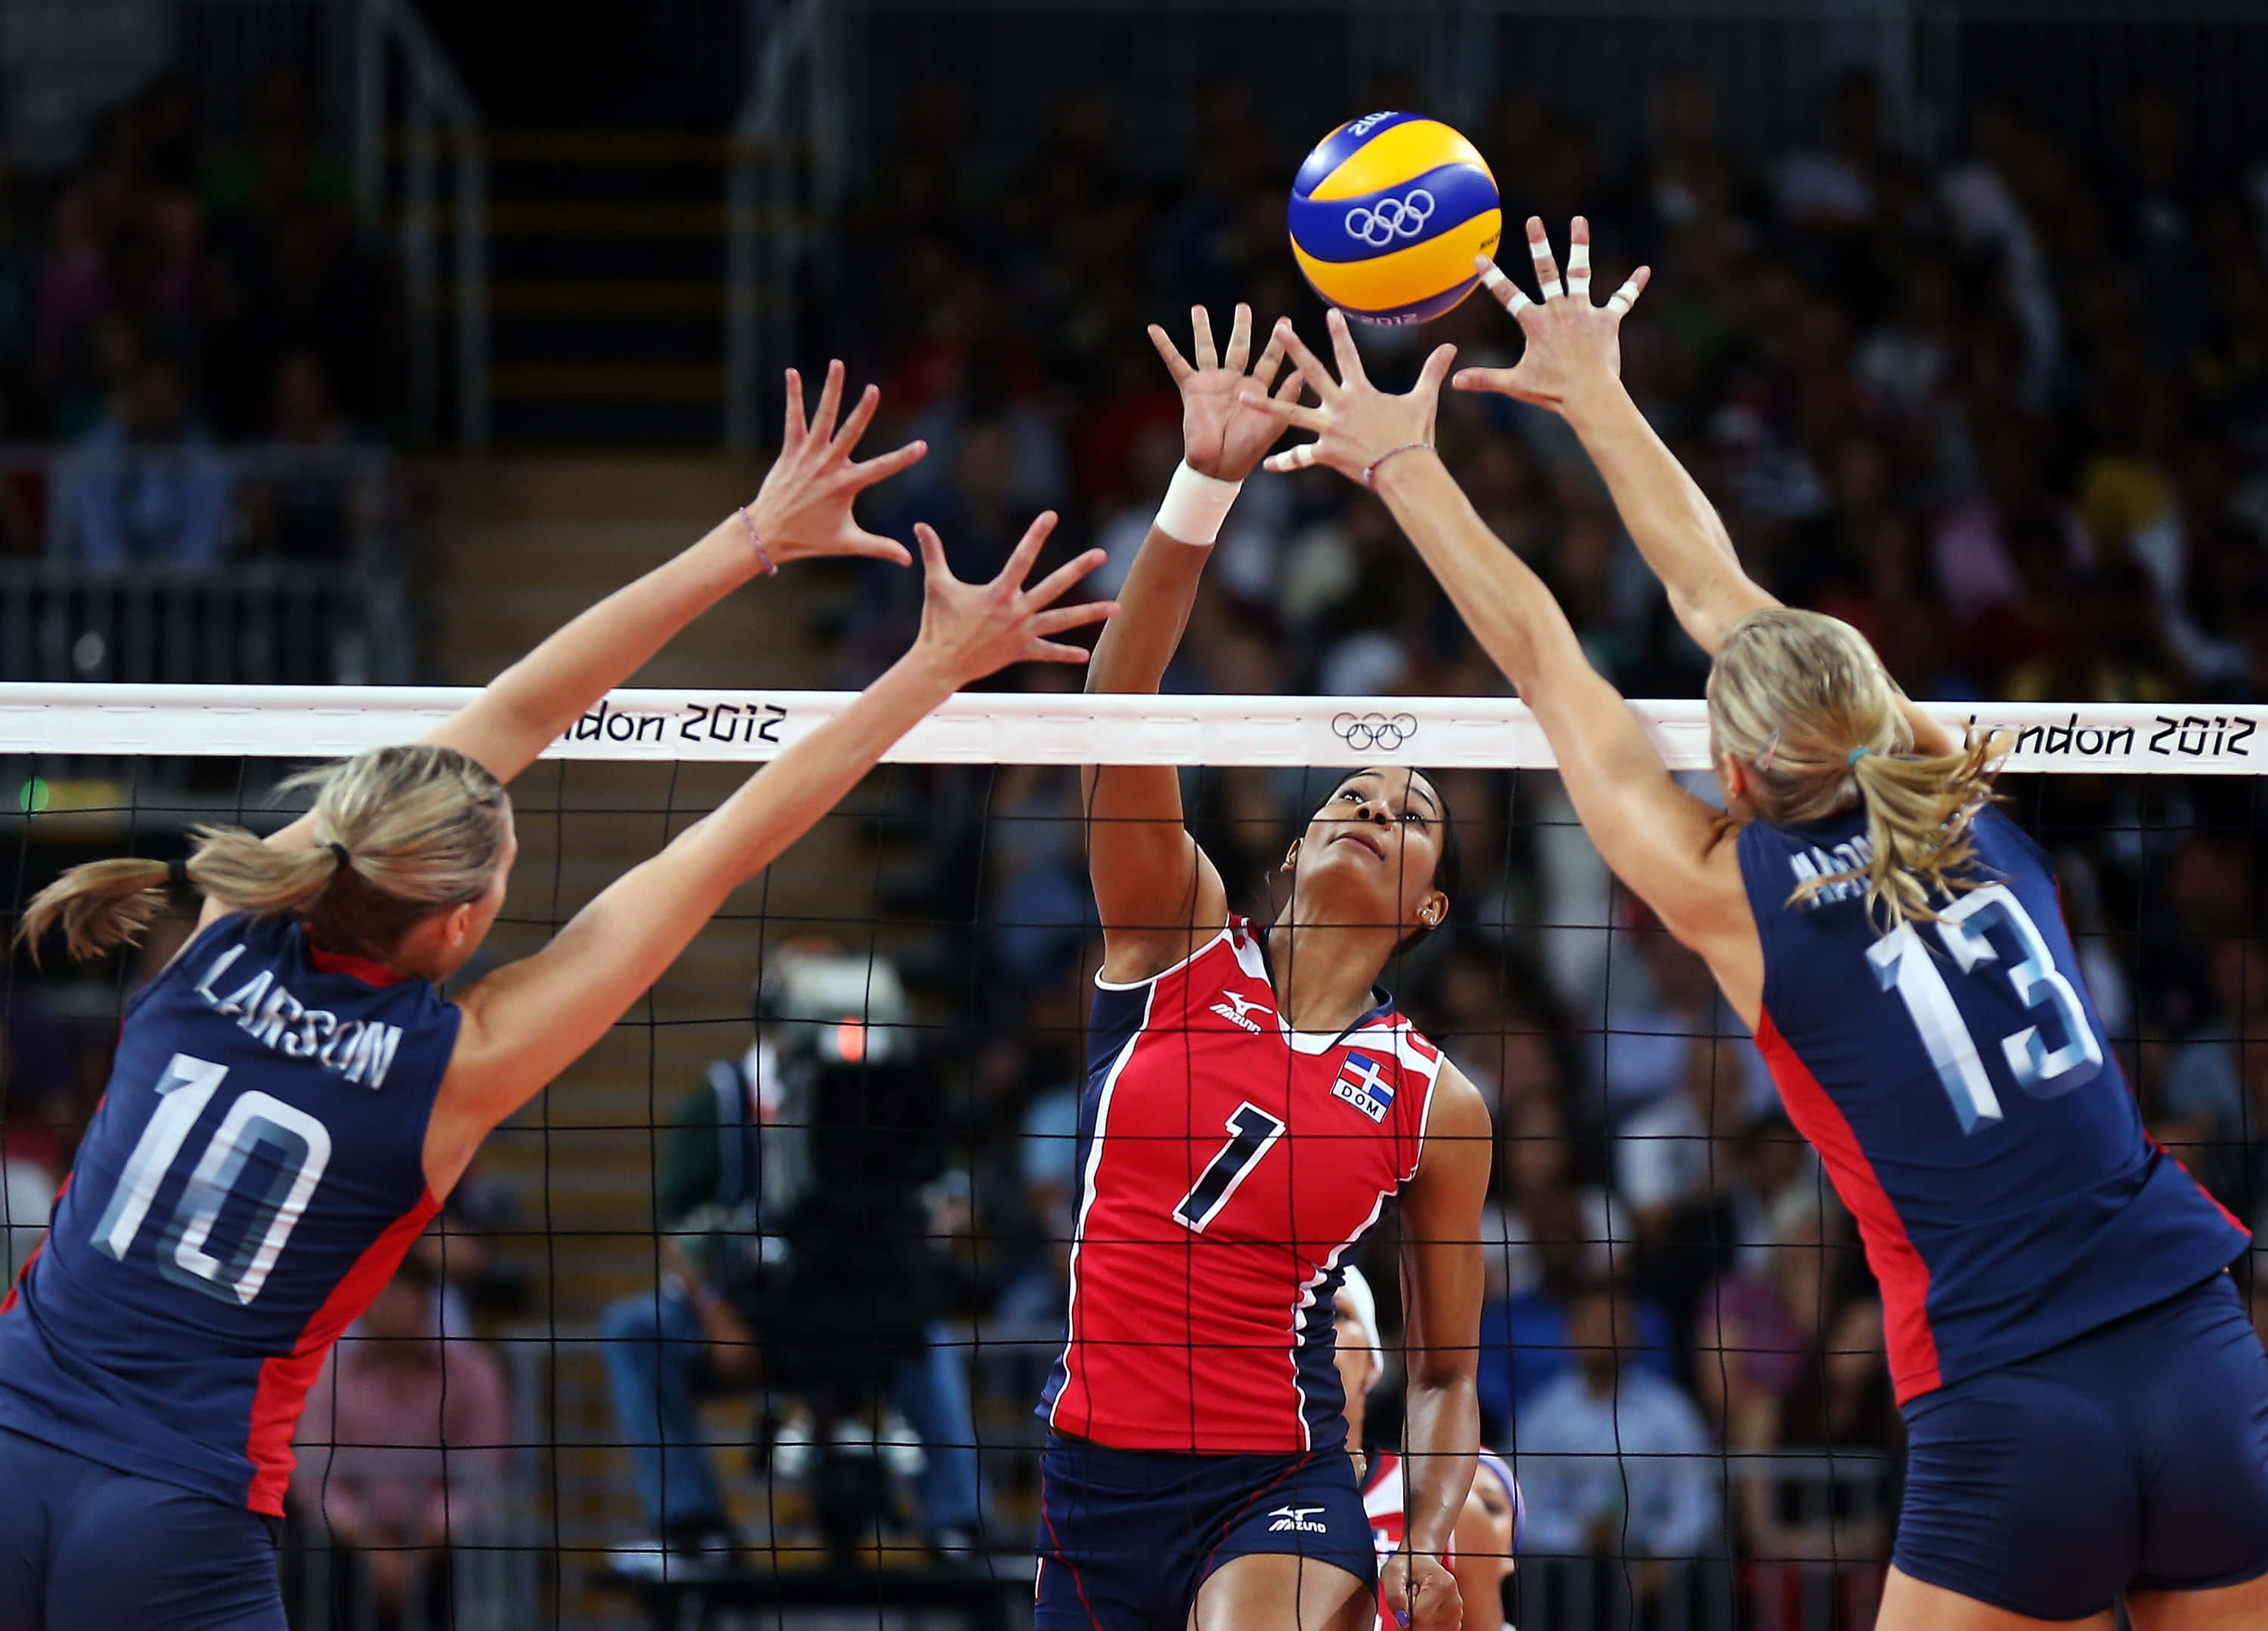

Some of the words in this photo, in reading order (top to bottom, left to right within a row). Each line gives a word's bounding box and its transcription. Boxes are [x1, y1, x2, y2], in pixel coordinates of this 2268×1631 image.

[680, 703, 787, 743] 2012
[2149, 715, 2257, 756] 2012
[194, 944, 403, 1090] LARSON
[1209, 1003, 1263, 1035] MIZUNO
[1864, 883, 2103, 1136] 13
[1340, 1085, 1380, 1117] DOM
[89, 1053, 333, 1307] 10
[1268, 1518, 1327, 1533] MIZUNO
